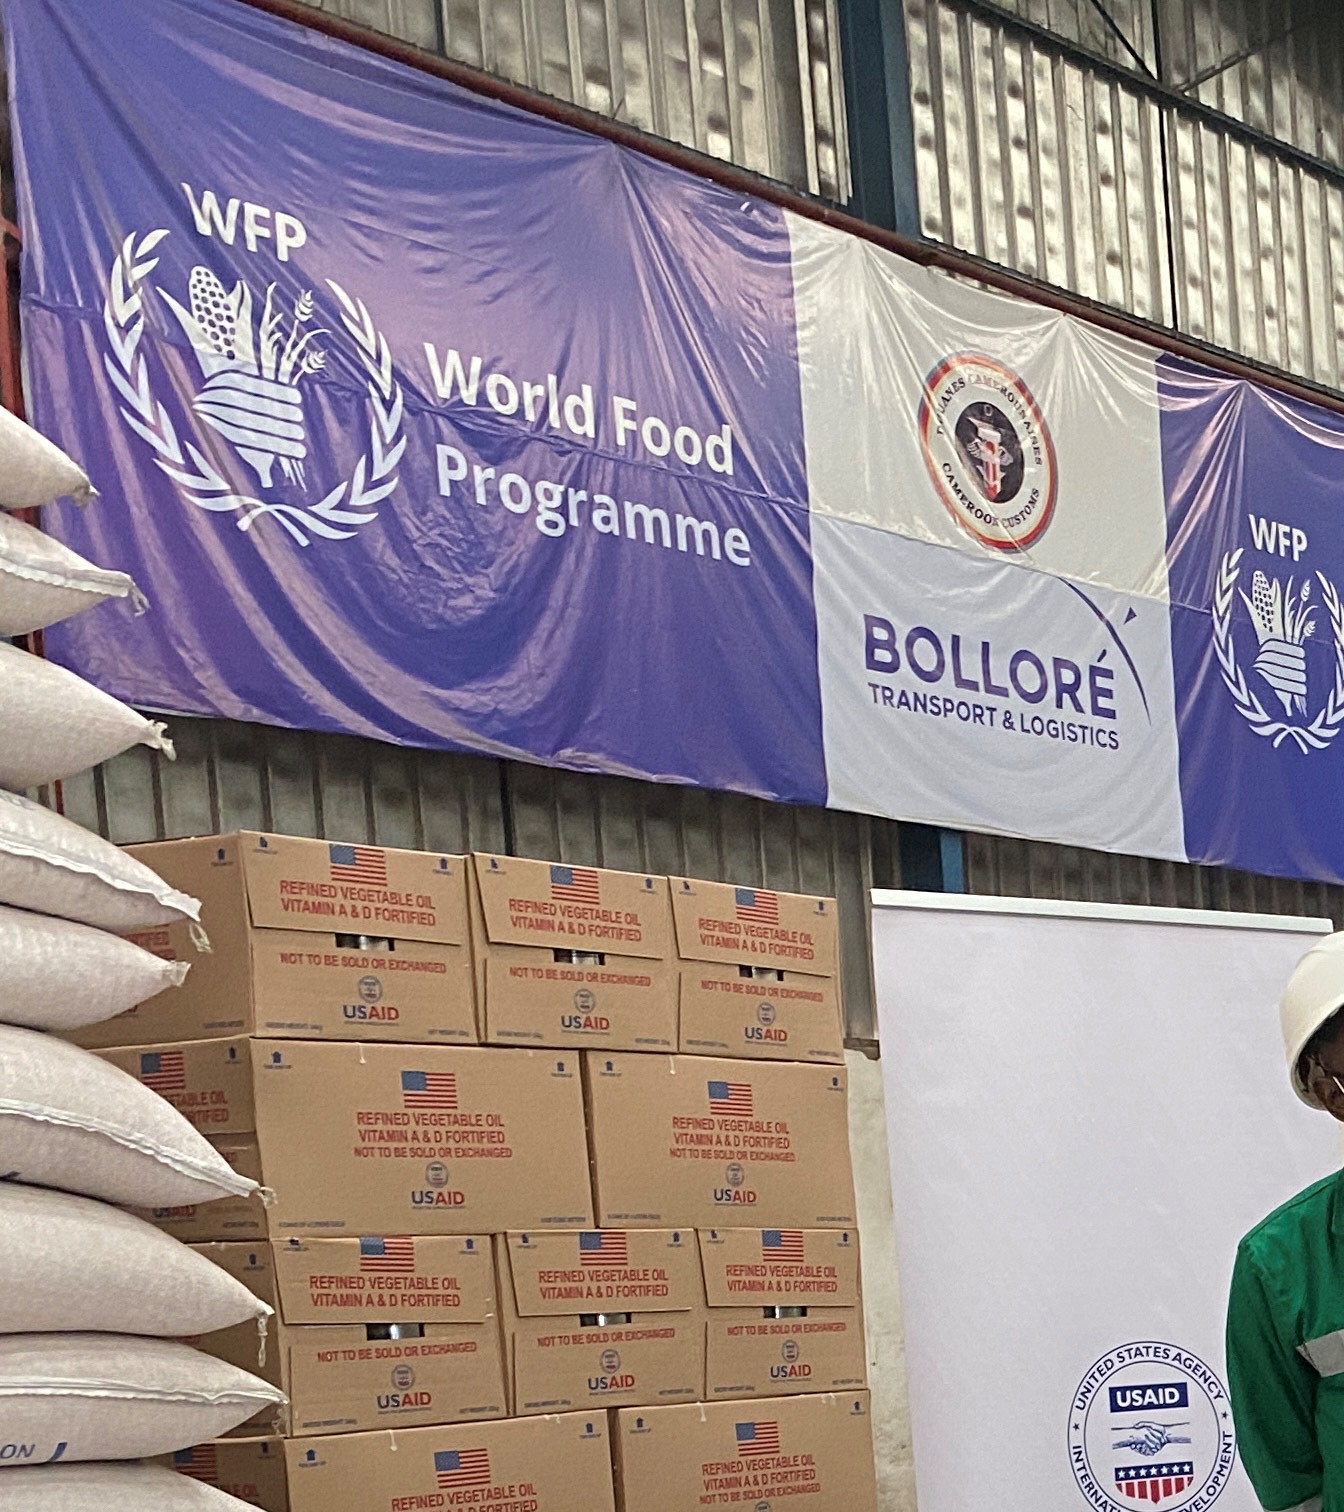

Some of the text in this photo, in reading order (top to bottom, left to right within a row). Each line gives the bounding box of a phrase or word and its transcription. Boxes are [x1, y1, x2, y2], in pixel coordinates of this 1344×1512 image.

[181, 182, 308, 260] WFP
[423, 342, 734, 476] World Food
[436, 444, 751, 567] Programme
[1001, 487, 1040, 528] CUSTOMS
[1249, 514, 1308, 561] WFP
[863, 614, 1118, 720] BOLLORÉ
[867, 682, 1120, 751] TRANSPORT & LOGISTICS
[280, 880, 435, 909] REFINED VEGETABLE OIL
[281, 899, 435, 925] VITAMIN A & D FORTIFIED
[280, 953, 446, 974] NOT TO BE SOLD OR EXCHANGED
[343, 1005, 399, 1021] USAID
[357, 1112, 504, 1127] REFINED VEGETABLE OIL
[359, 1131, 505, 1144] VITAMIN A & D FORTIFIED
[354, 1147, 512, 1158] NOT TO BE SOLD OR EXCHANGED
[412, 1191, 464, 1205] USAID
[1075, 1346, 1225, 1411] UNITED STATES AGENCY
[1116, 1387, 1180, 1407] USAID
[392, 1483, 537, 1511] REFINED VEGETABLE OIL
